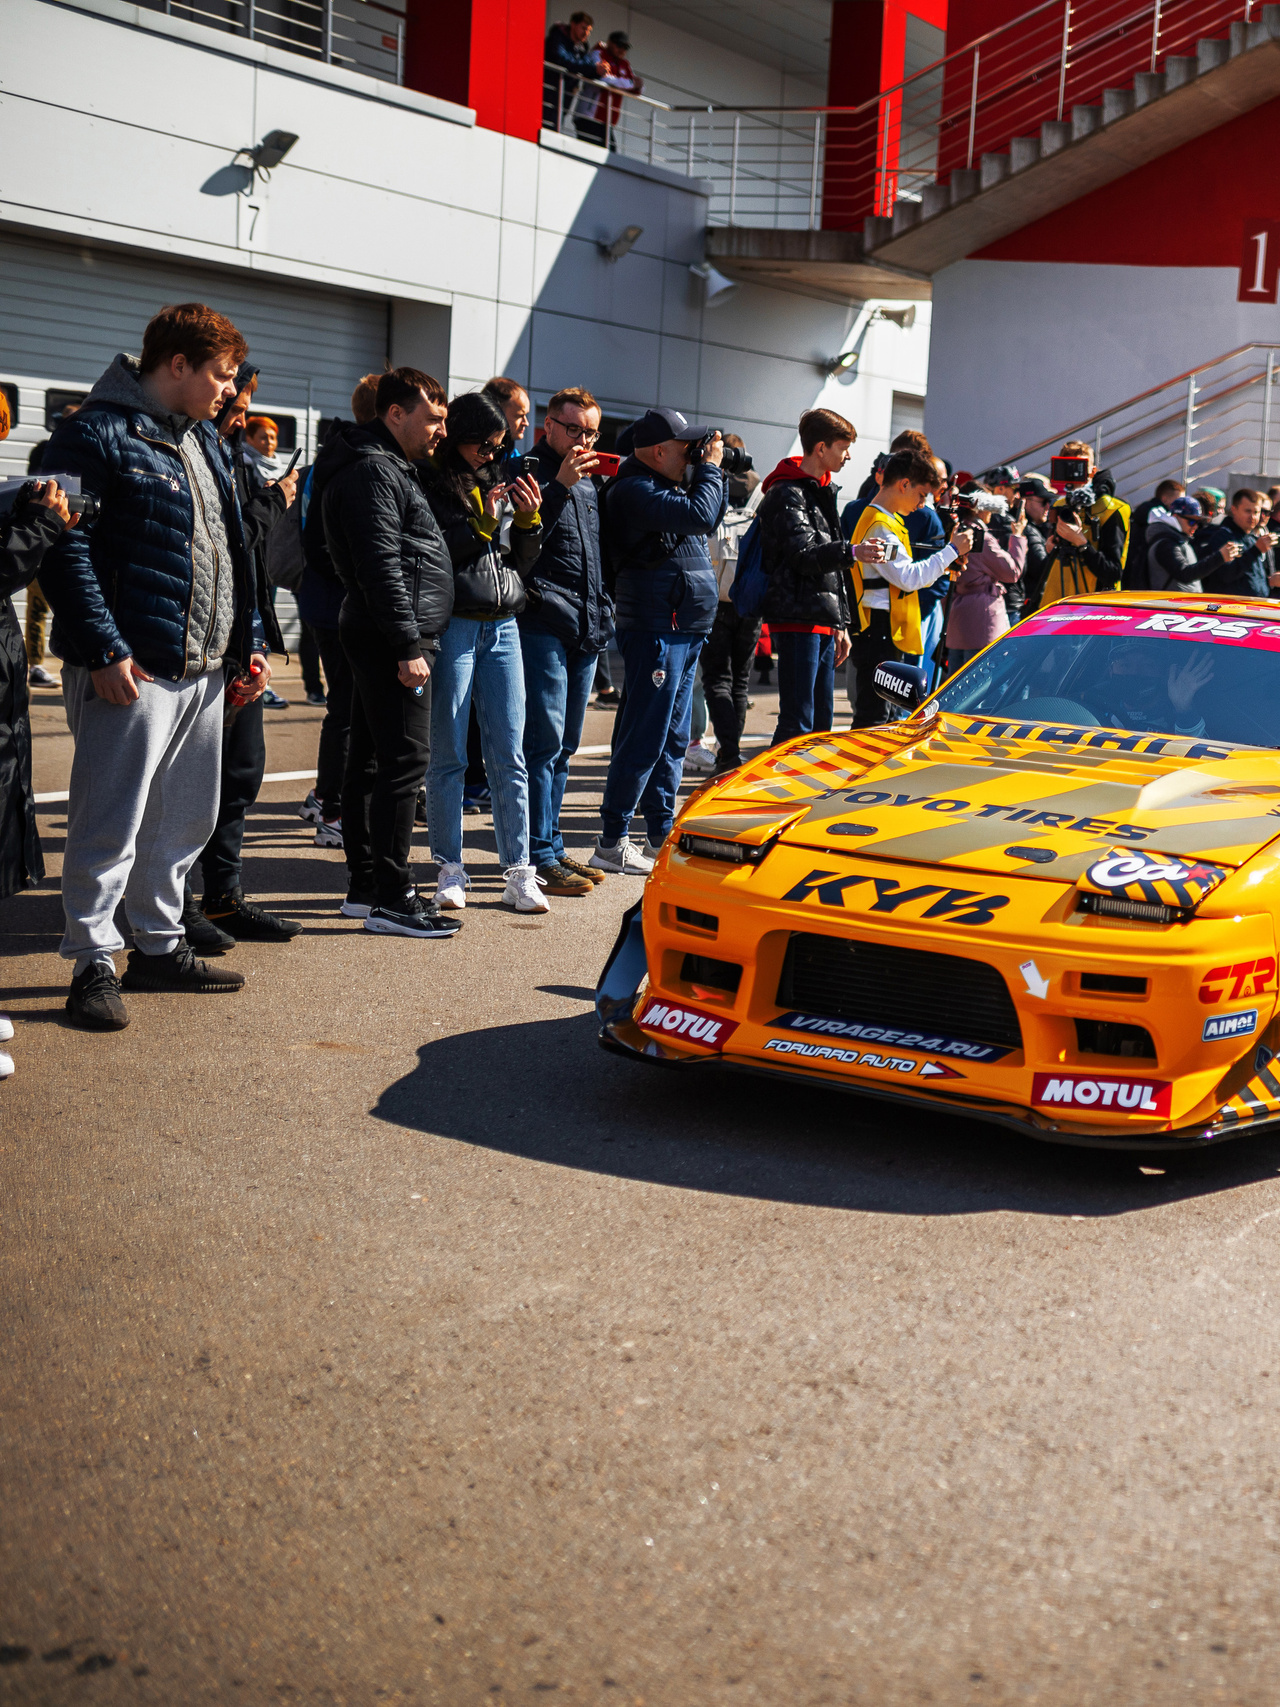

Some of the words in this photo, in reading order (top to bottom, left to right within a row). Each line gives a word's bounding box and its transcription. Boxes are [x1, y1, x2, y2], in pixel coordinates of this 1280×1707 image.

[248, 205, 260, 241] 7
[1248, 232, 1269, 293] 1
[1134, 613, 1264, 639] RDS
[873, 667, 914, 698] MAHLE
[962, 720, 1236, 760] MAHLE
[813, 788, 970, 813] TOYO
[971, 803, 1160, 841] TIRES
[1091, 857, 1191, 887] Ca
[781, 869, 1011, 925] KYB
[1198, 956, 1276, 1005] CTR
[641, 1004, 723, 1044] MOTUL
[790, 1016, 993, 1058] VIRAGE24.RU
[1205, 1015, 1254, 1037] AIMOL
[764, 1039, 860, 1063] FORWARD
[860, 1053, 916, 1072] AUTO
[1041, 1079, 1159, 1111] MOTUL
